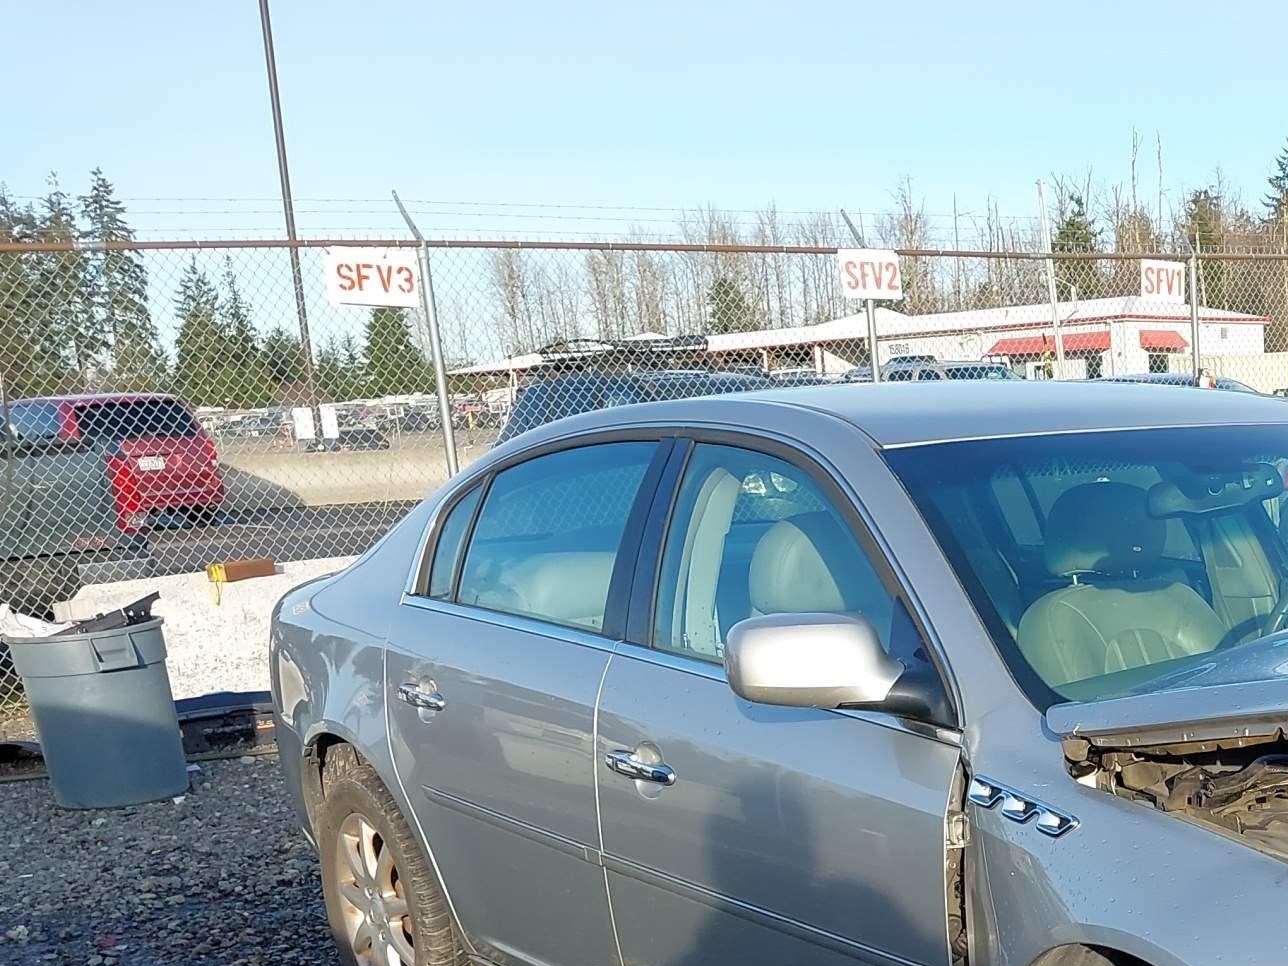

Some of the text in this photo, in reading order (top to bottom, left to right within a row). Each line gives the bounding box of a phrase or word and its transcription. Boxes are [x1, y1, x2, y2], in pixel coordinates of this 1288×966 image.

[336, 263, 415, 294] SFV3
[845, 260, 899, 290] SFV2
[1144, 266, 1182, 297] SFV1
